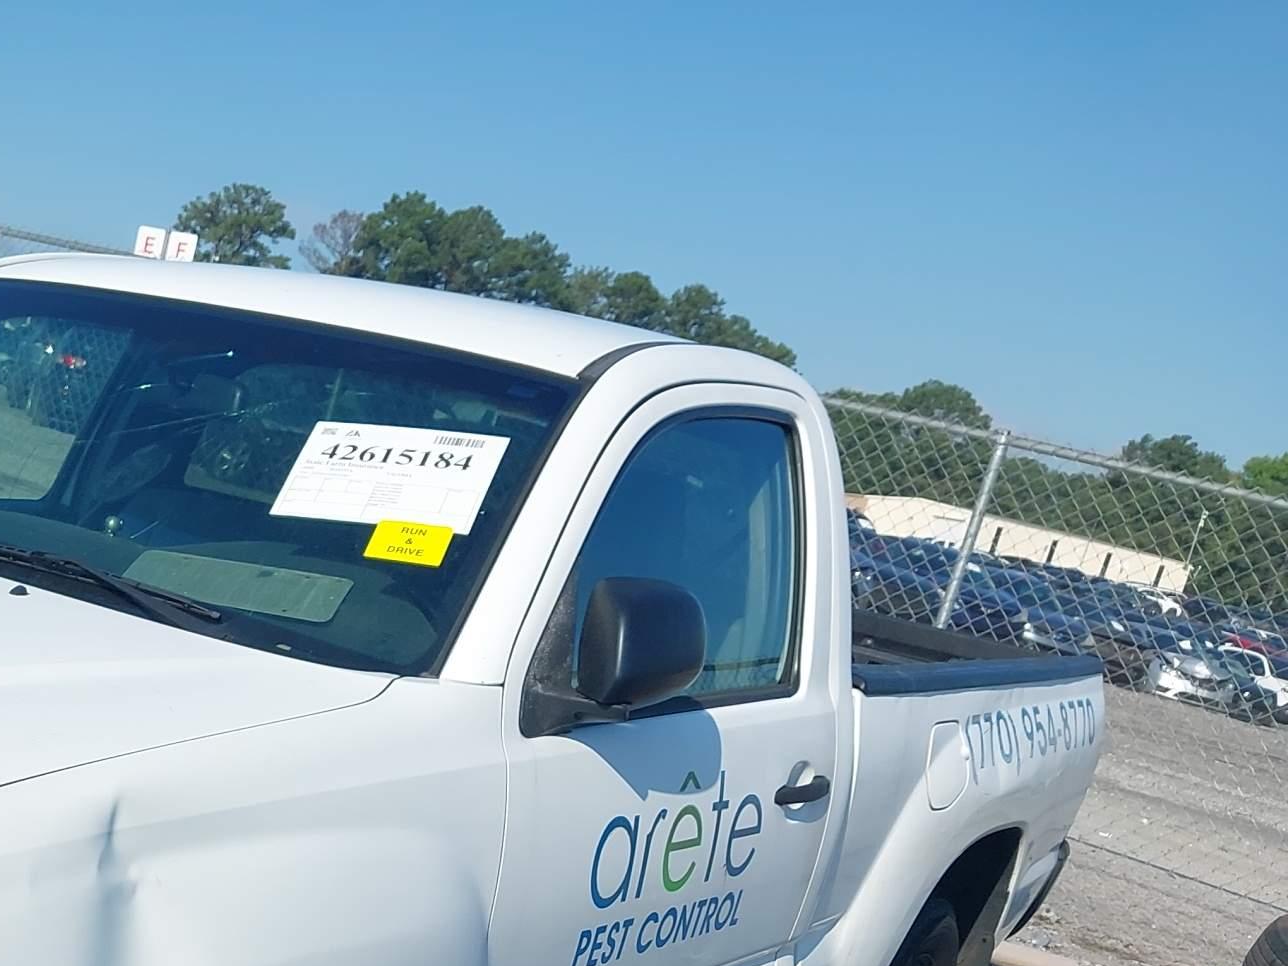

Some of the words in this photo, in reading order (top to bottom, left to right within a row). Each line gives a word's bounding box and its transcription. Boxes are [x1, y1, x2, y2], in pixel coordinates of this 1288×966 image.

[144, 236, 156, 254] E
[175, 241, 188, 258] F
[321, 442, 474, 471] 42615184
[400, 526, 428, 536] RUN
[405, 537, 414, 545] &
[386, 545, 425, 557] DRIVE
[964, 707, 1022, 785] (770)
[1021, 696, 1096, 759] 954-8770
[589, 770, 763, 909] arête
[635, 888, 744, 955] CONTROL
